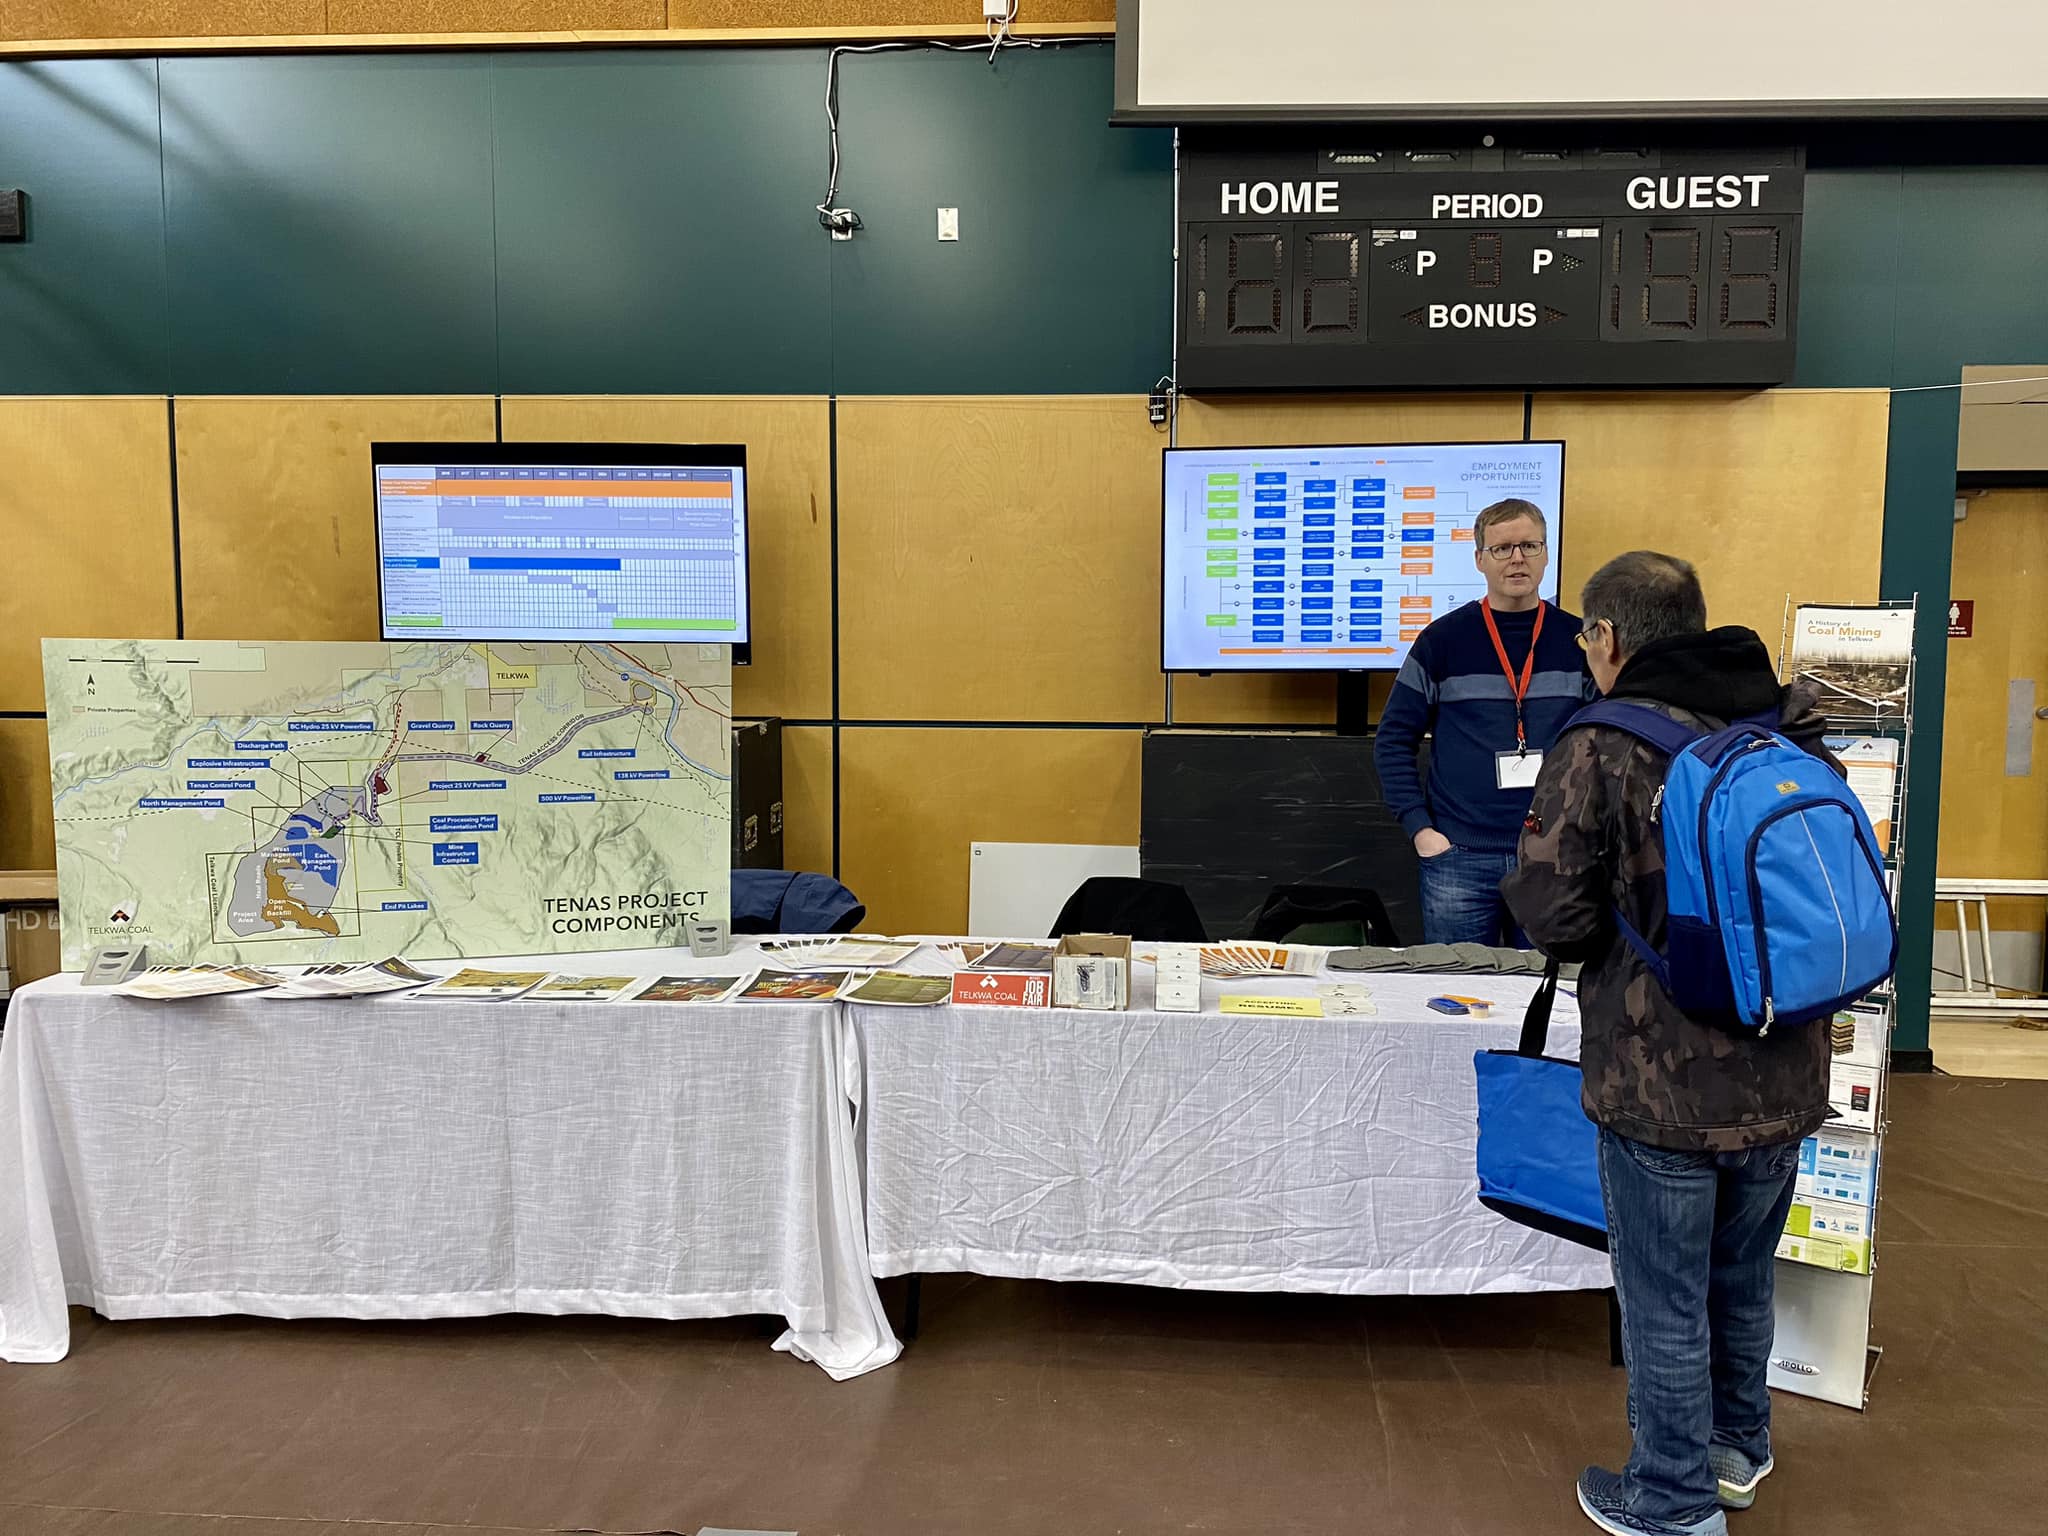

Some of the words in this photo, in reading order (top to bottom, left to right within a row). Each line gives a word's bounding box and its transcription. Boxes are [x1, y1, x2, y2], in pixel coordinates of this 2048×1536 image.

[1220, 181, 1340, 215] HOME
[1625, 175, 1770, 209] GUEST
[1432, 193, 1544, 219] PERIOD
[1416, 250, 1437, 276] P
[1532, 249, 1554, 274] P
[1428, 303, 1537, 329] BONUS
[1471, 462, 1542, 471] EMPLOYMENT
[1460, 472, 1542, 481] OPPORTUNITIES
[1807, 625, 1835, 635] Coal
[1839, 627, 1882, 639] Mining
[496, 672, 530, 680] TELKWA
[88, 687, 96, 696] N
[301, 723, 321, 731] Hydro
[431, 722, 454, 730] Quarry
[517, 750, 538, 765] TENAS
[537, 735, 558, 754] ACCESS
[556, 713, 585, 738] CORRIDOR
[191, 760, 222, 768] Explosive
[434, 823, 478, 831] Sedimentation
[446, 816, 480, 824] Processing
[543, 896, 611, 913] TENAS
[617, 891, 709, 910] PROJECT
[88, 926, 126, 935] TELKWA
[127, 925, 154, 934] COAL
[552, 912, 700, 934] COMPONENTS
[1024, 980, 1044, 995] JOB
[959, 991, 993, 1000] TELKWA
[993, 992, 1018, 1001] COAL
[1022, 992, 1044, 1006] FAIR
[1776, 1360, 1813, 1374] APOLLO
